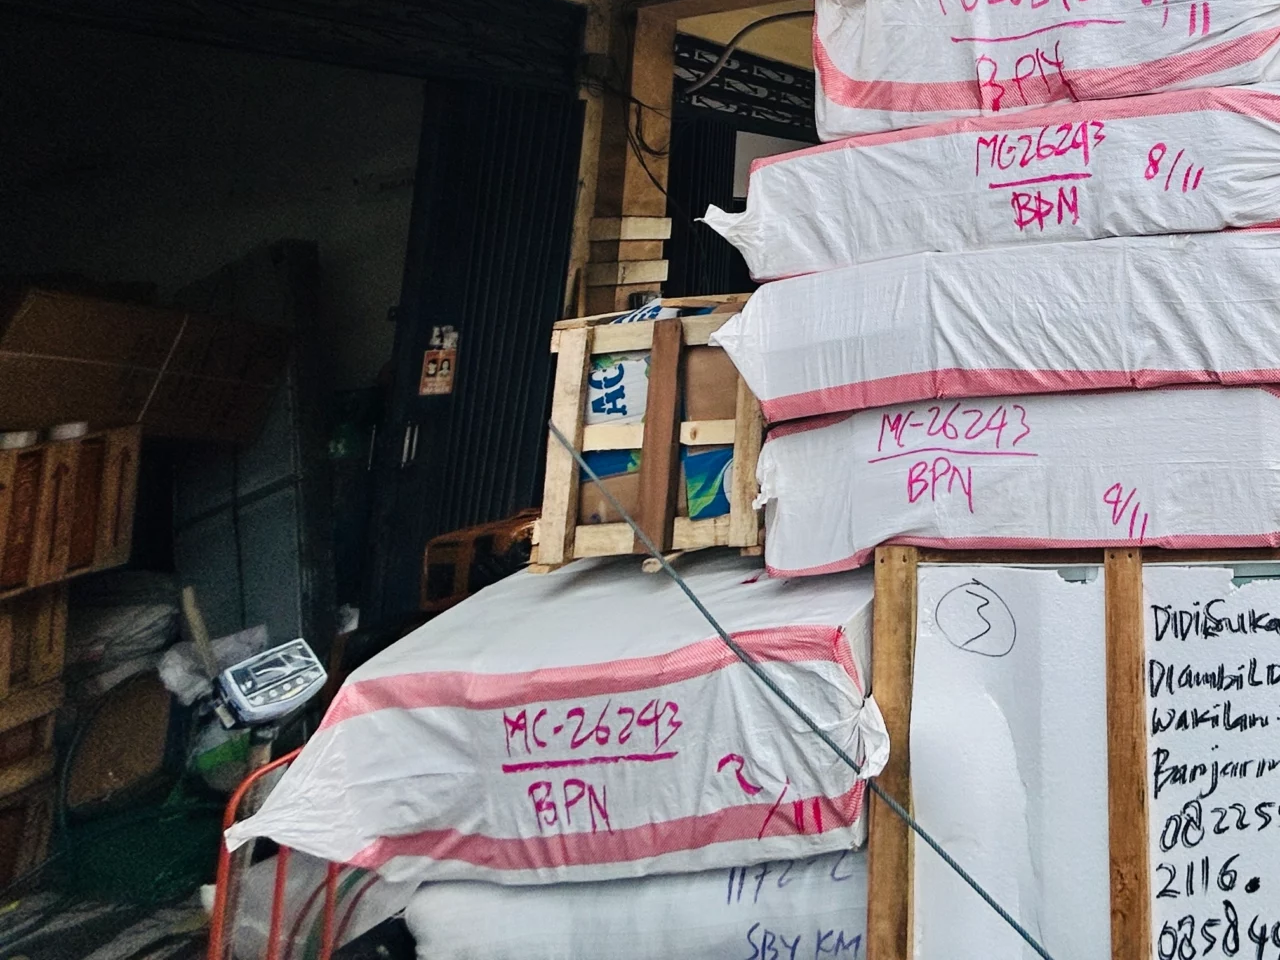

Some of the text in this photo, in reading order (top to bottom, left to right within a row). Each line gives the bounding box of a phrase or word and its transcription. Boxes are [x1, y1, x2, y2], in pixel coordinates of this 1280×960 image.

[1144, 142, 1205, 193] 8/11
[1010, 185, 1080, 232] BPN
[908, 456, 975, 514] BPN
[527, 778, 614, 836] BPN
